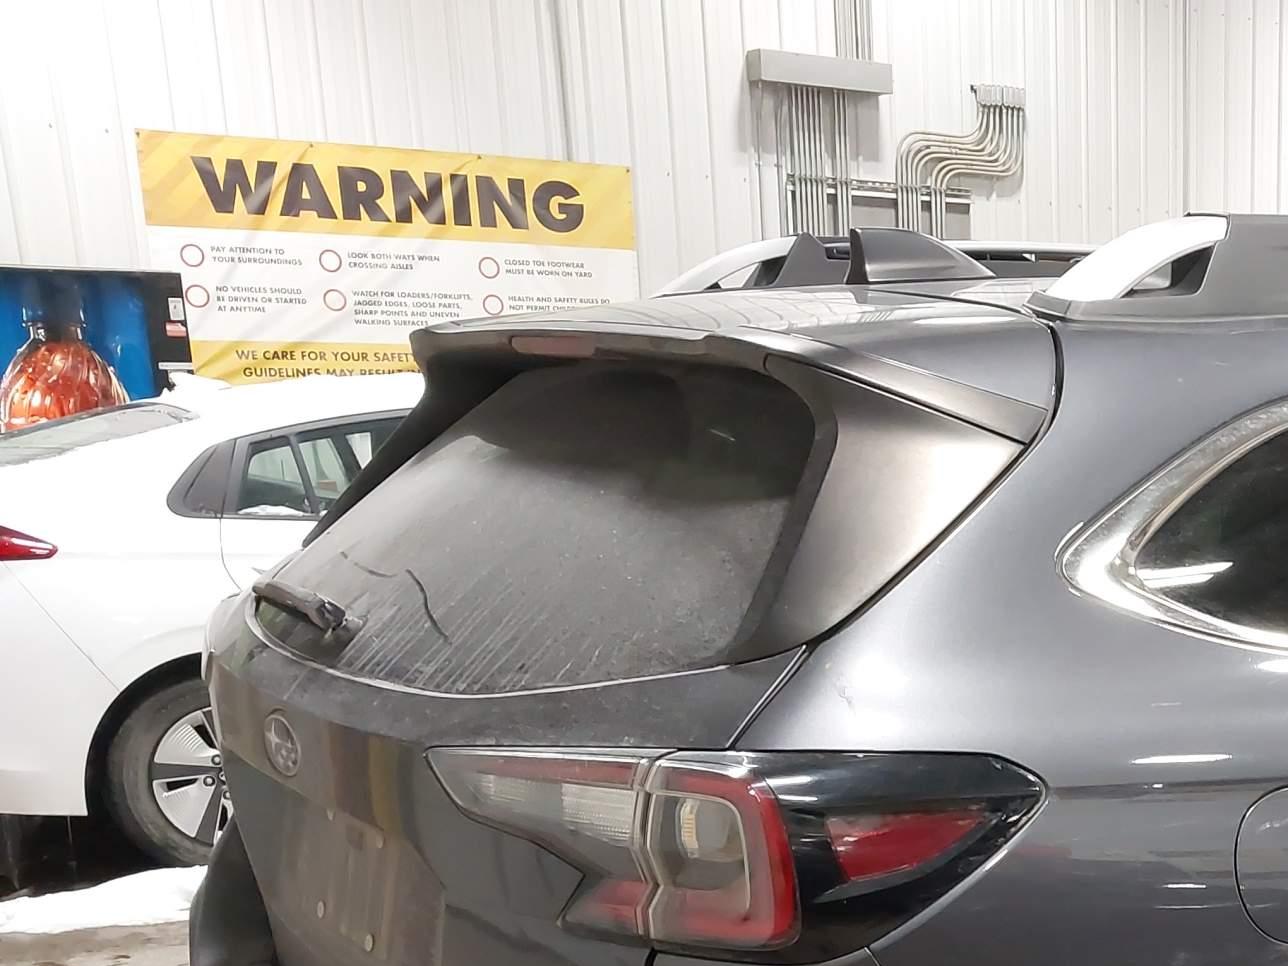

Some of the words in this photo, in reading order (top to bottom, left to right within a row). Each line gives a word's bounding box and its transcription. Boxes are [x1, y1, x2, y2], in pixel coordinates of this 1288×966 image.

[190, 155, 585, 233] WARNING
[238, 257, 303, 266] SURROUNDINGS
[348, 261, 388, 269] CROSSING
[547, 261, 585, 269] FOOTWEAR
[231, 286, 267, 294] VEHICLES
[270, 287, 302, 295] SHOULD
[275, 297, 307, 305] STARTED
[554, 296, 578, 304] SAFETY
[380, 309, 408, 317] POINTS
[235, 349, 258, 360] WE
[263, 350, 297, 361] CARE
[301, 351, 328, 361] FOR
[332, 351, 370, 362] YOUR
[243, 367, 321, 378] GUIDELINES
[326, 368, 355, 377] MAY
